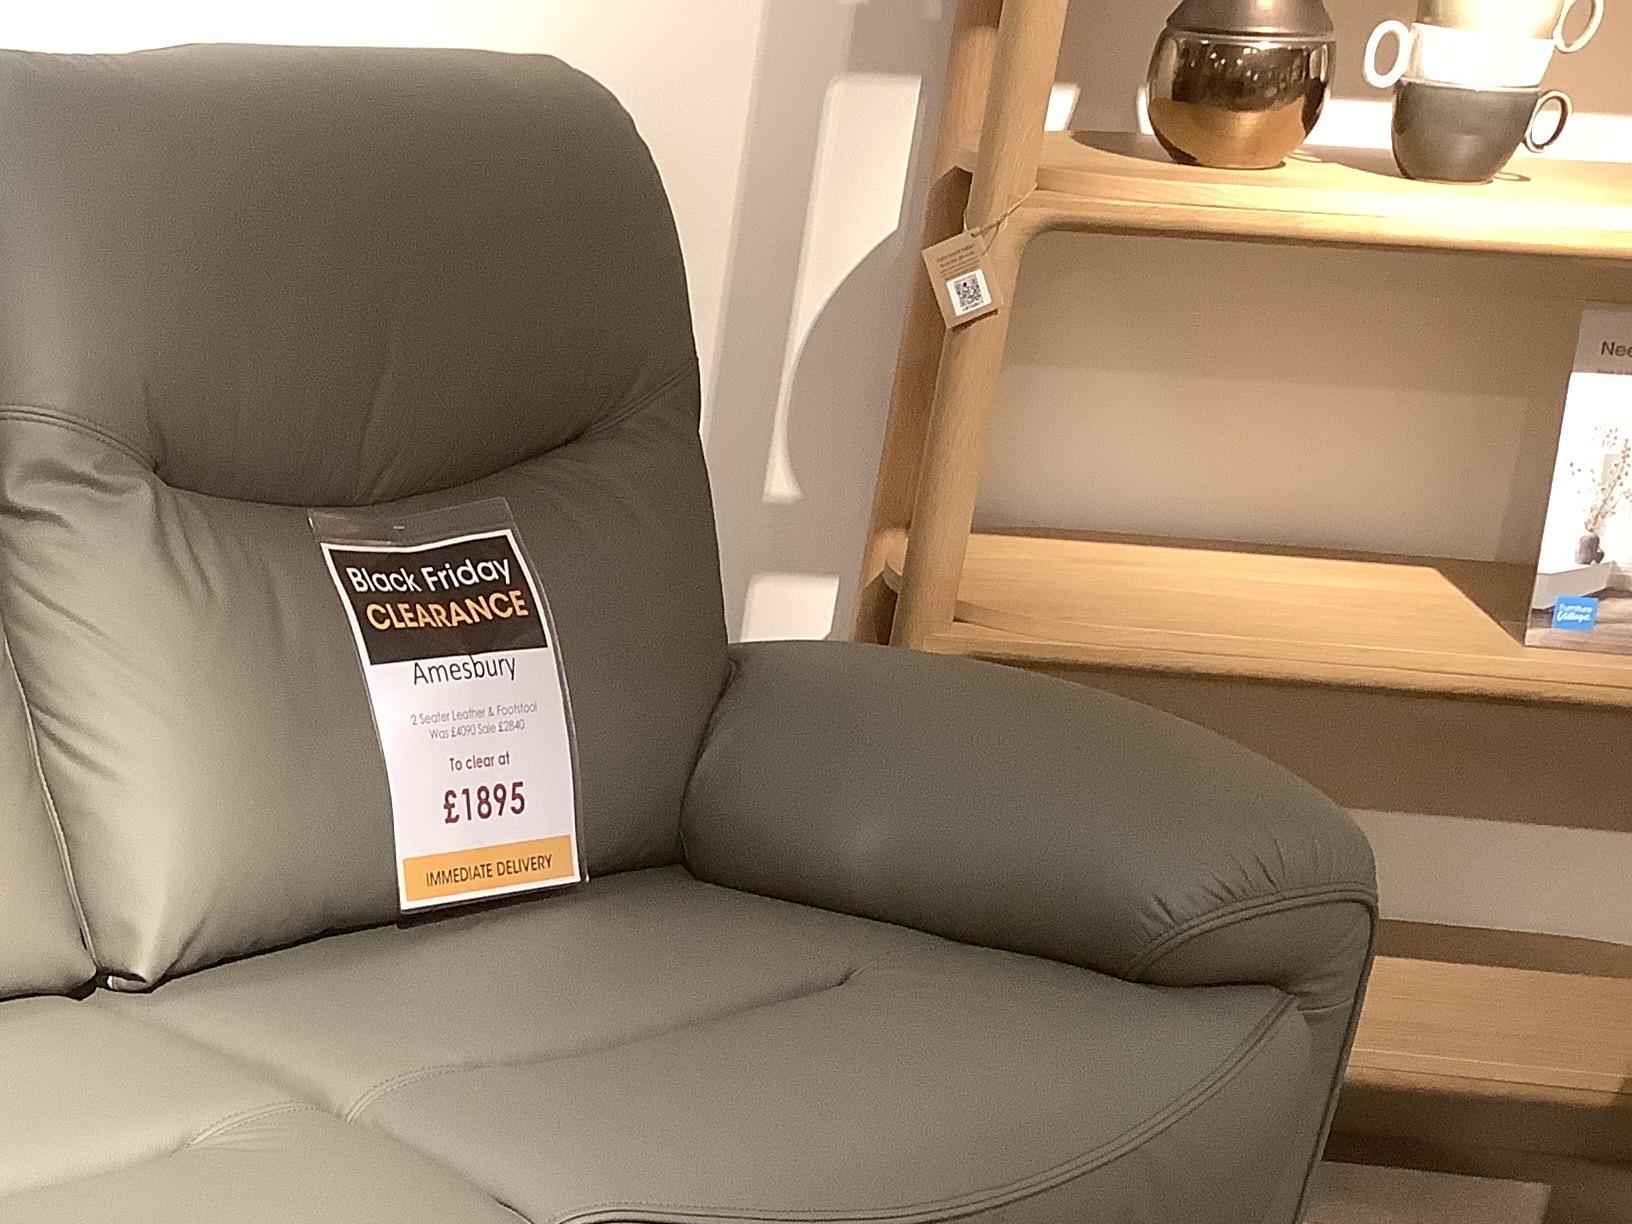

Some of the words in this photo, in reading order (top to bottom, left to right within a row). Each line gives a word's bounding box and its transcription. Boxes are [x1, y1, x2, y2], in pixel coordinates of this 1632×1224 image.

[346, 566, 422, 593] Black
[421, 558, 511, 593] Friday
[366, 590, 530, 631] CLEARANCE
[413, 654, 517, 686] Amesbury
[411, 713, 418, 726] 2
[419, 711, 450, 725] Seater
[451, 707, 486, 721] Leather
[487, 706, 495, 717] &
[496, 701, 538, 716] Footstool
[429, 728, 449, 739] Was
[478, 722, 496, 735] Sale
[498, 718, 526, 733] £2840
[449, 757, 463, 772] To
[465, 754, 495, 770] clear
[498, 750, 510, 766] at
[443, 780, 526, 824] £1895
[426, 863, 493, 887] IMMEDIATE
[496, 854, 553, 877] DELIVERY
